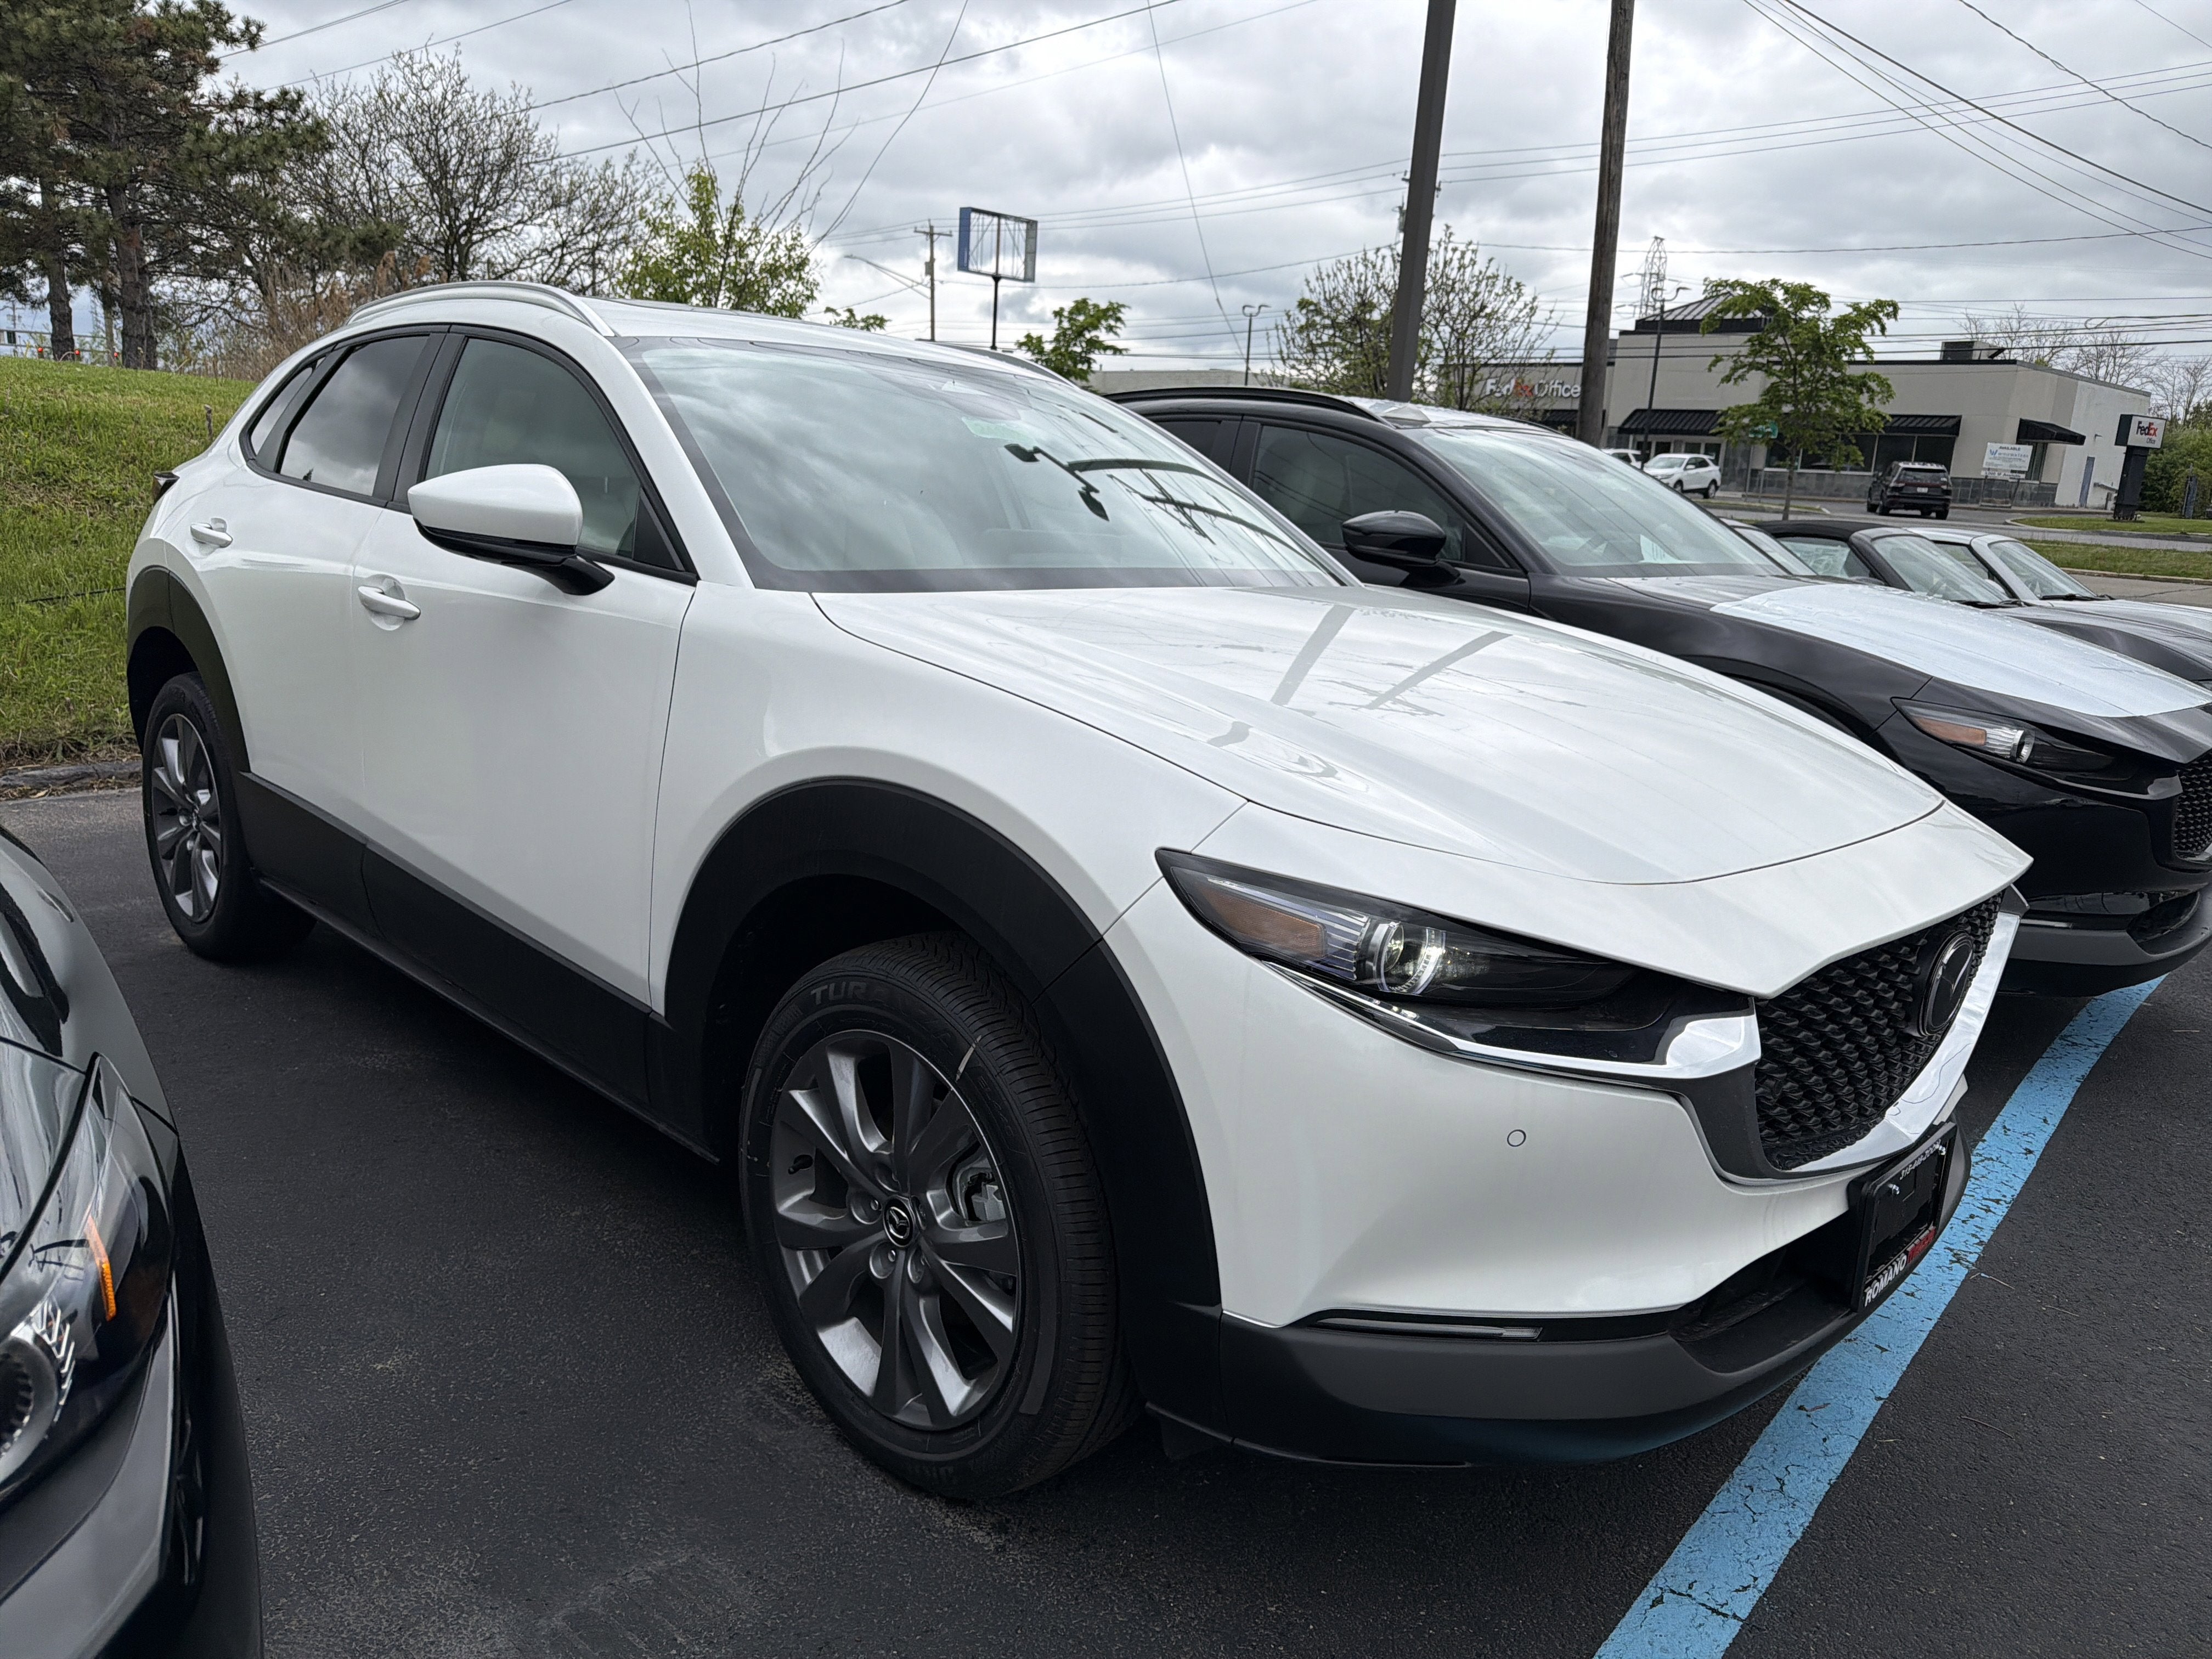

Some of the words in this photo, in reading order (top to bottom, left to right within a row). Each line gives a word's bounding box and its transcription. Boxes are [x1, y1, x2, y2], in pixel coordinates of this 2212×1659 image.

[1535, 379, 1581, 397] Office
[2136, 420, 2158, 437] FedEx
[1865, 1254, 1908, 1308] ROMANO
